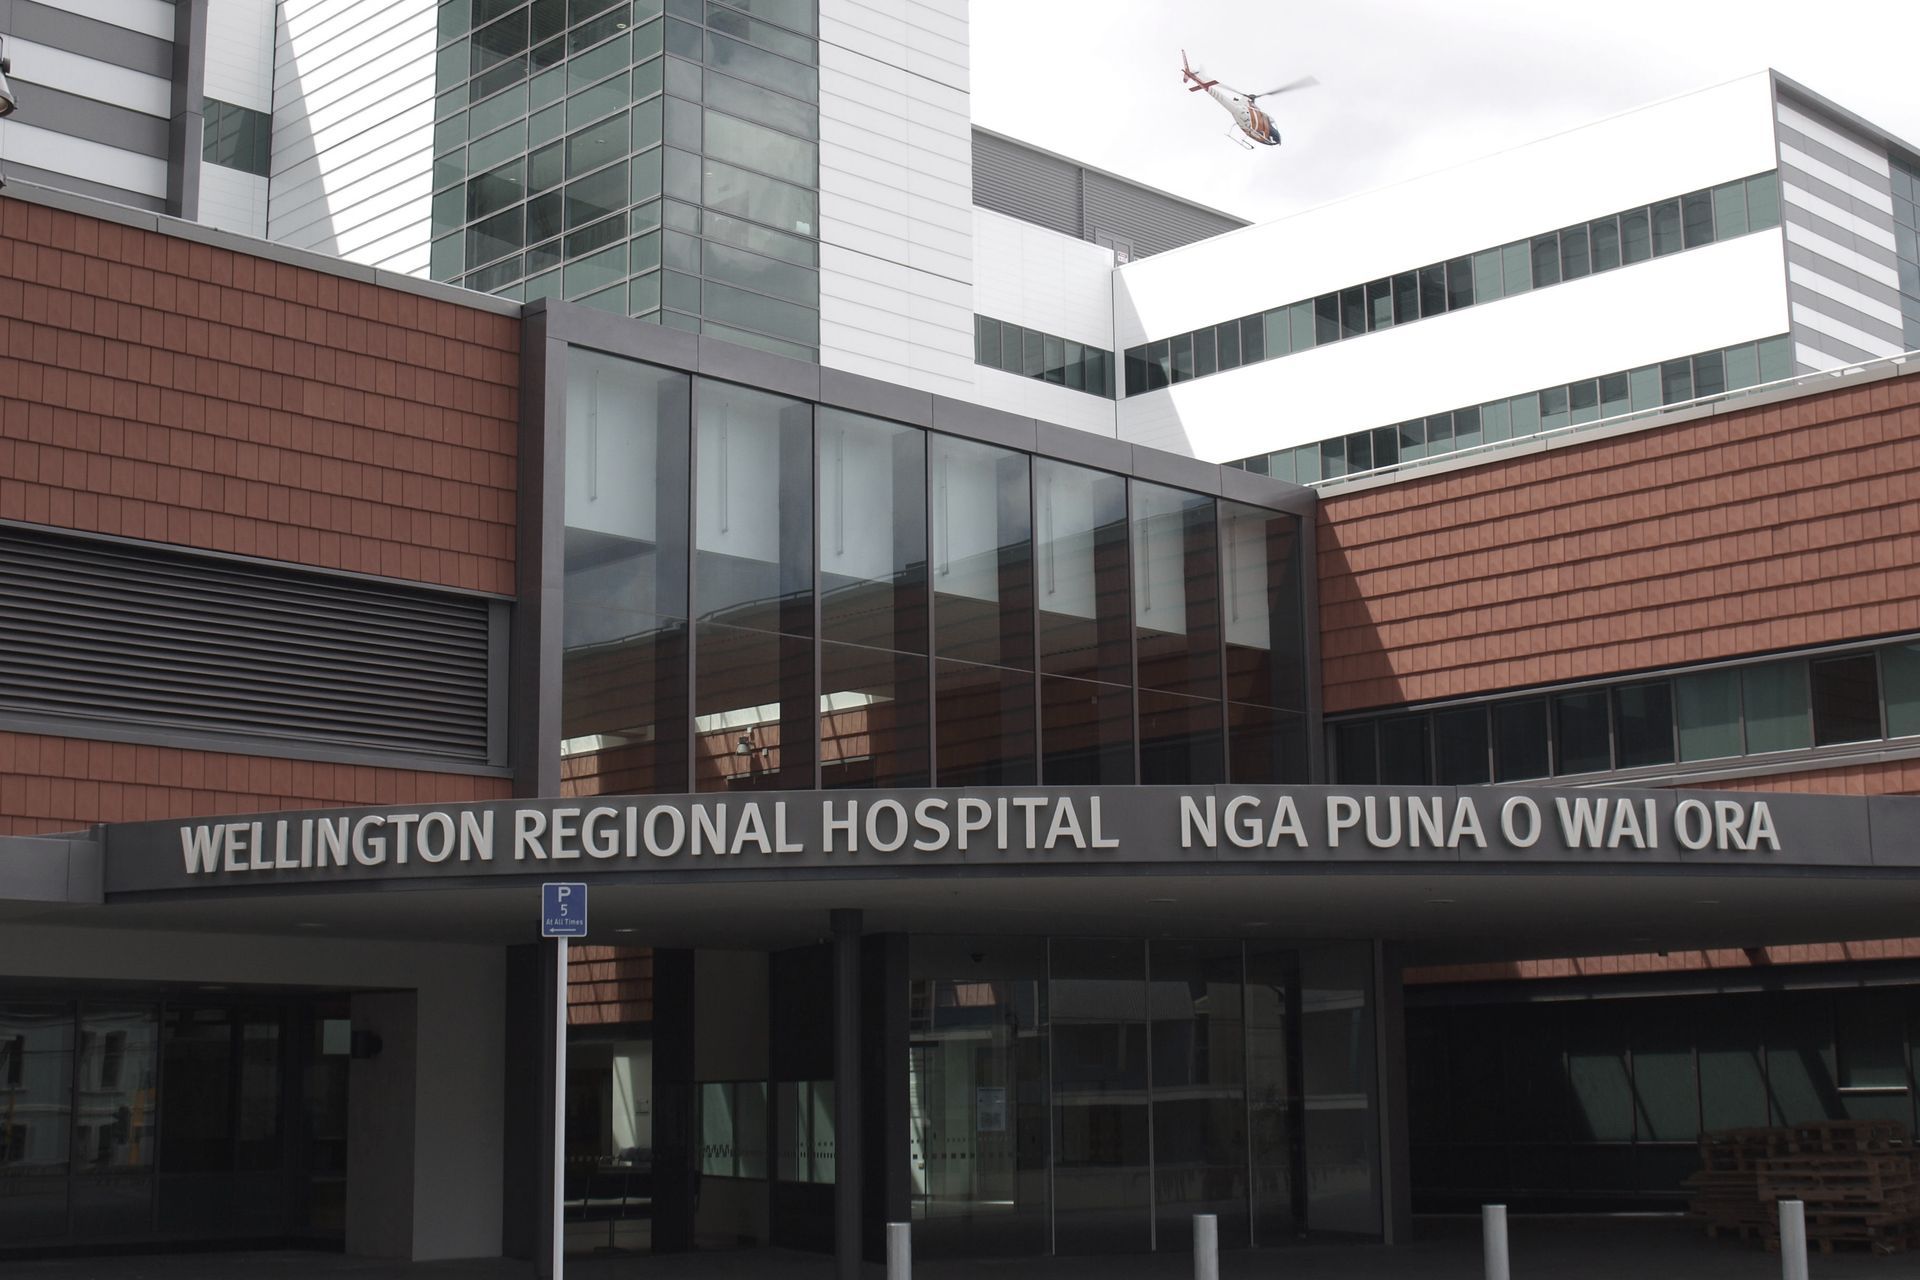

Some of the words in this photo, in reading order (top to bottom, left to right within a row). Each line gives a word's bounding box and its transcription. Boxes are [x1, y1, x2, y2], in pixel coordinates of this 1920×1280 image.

[180, 808, 495, 875] WELLINGTON
[514, 799, 805, 861] REGIONAL
[822, 795, 1121, 854] HOSPITAL
[1180, 795, 1309, 849] NGA
[1326, 795, 1488, 848] PUNA
[1501, 795, 1543, 849] O
[1555, 796, 1658, 849] WAI
[1674, 798, 1783, 852] ORA
[558, 886, 571, 903] P
[560, 904, 568, 917] 5
[546, 918, 553, 926] At
[554, 918, 563, 926] All
[564, 918, 584, 926] Times
